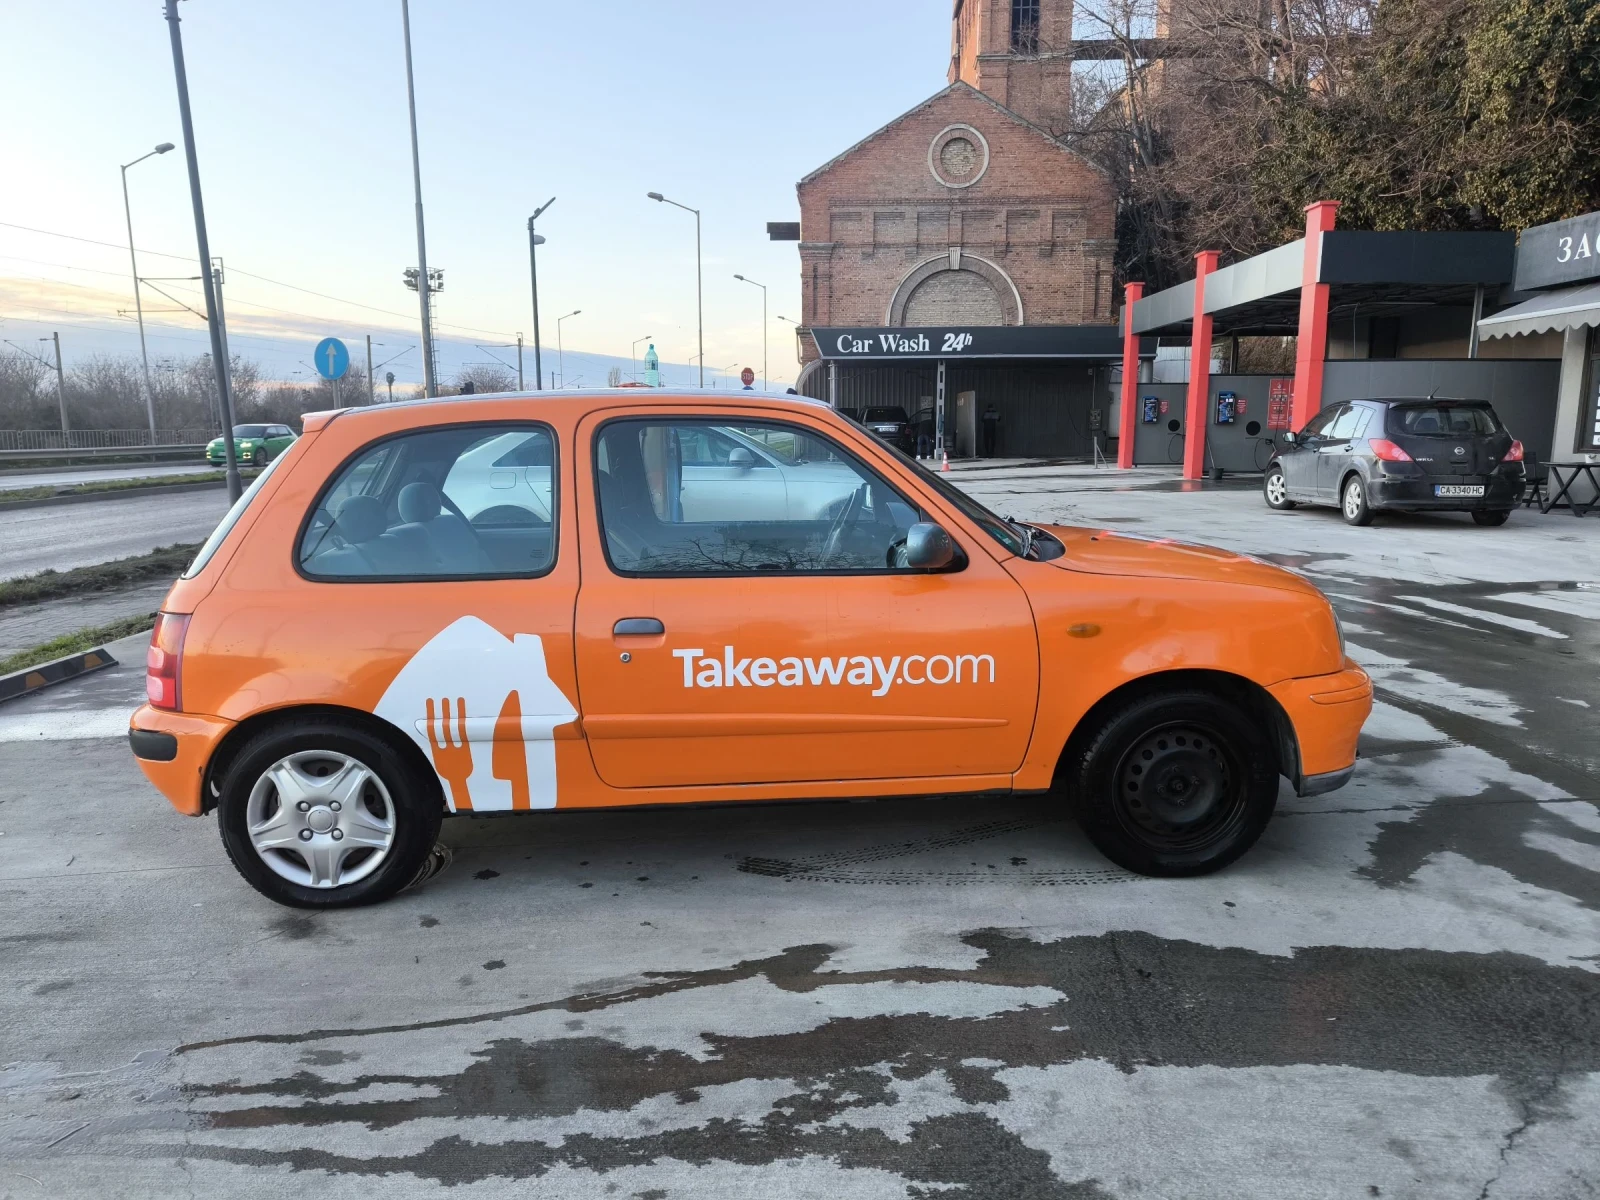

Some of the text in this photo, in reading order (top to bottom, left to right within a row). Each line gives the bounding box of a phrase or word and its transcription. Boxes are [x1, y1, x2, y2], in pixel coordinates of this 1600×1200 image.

[1556, 232, 1600, 263] ЗА
[836, 332, 973, 353] Car Wash 24h
[672, 645, 995, 697] Takeaway.com
